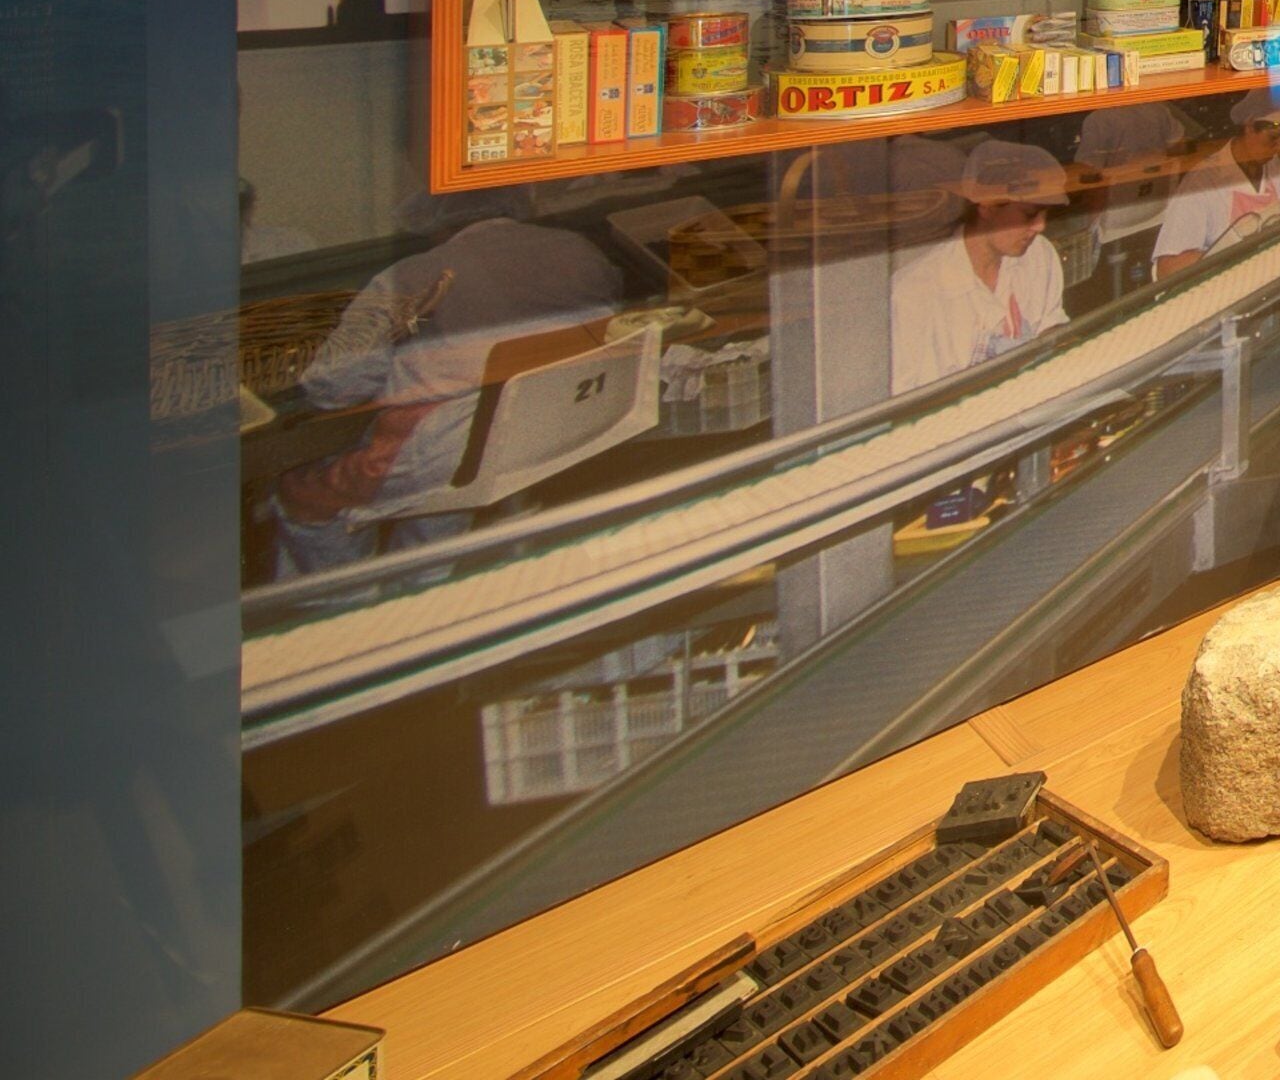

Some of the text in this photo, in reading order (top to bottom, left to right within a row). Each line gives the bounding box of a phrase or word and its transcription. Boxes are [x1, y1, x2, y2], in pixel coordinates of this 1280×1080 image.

[568, 39, 584, 68] ROSA
[841, 76, 853, 84] DE
[858, 73, 907, 84] PESCADOS
[780, 78, 950, 113] ORTIZ S.A.
[573, 369, 607, 404] 21
